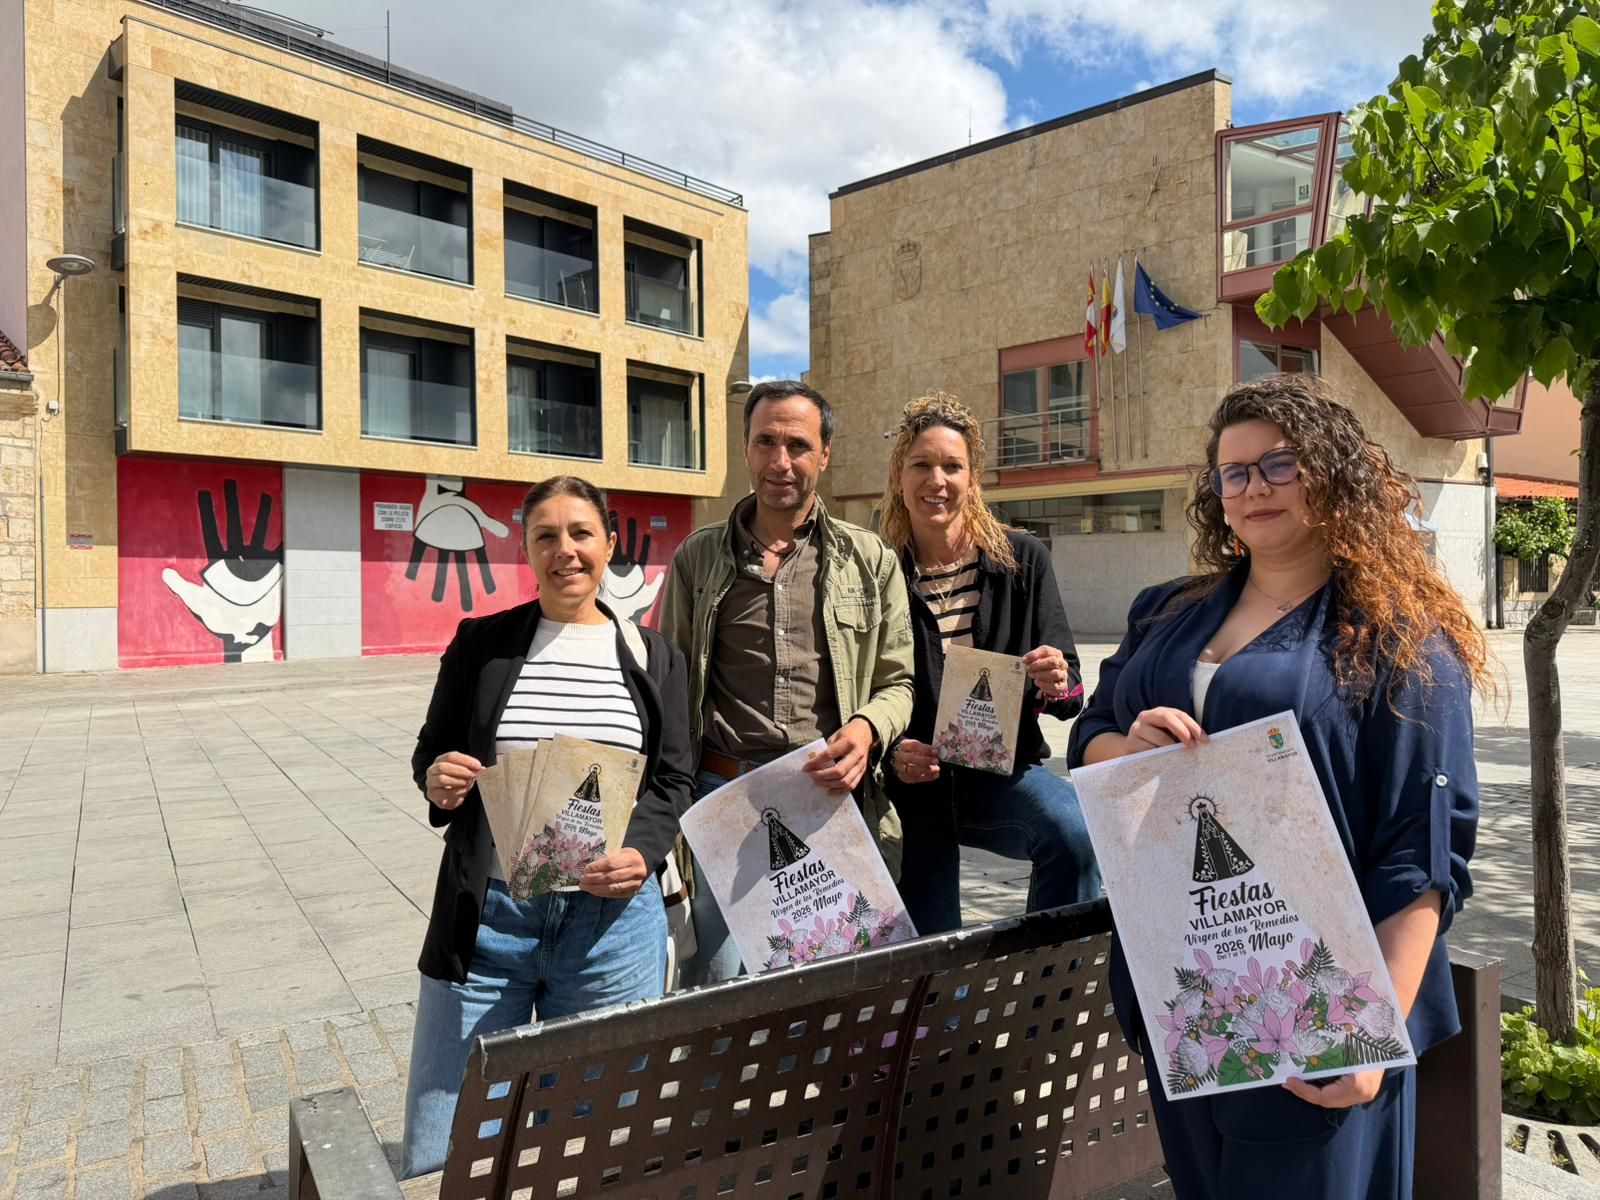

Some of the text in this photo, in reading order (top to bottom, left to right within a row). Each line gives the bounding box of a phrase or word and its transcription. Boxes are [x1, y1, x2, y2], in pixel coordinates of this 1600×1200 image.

[965, 699, 994, 714] Fiestas
[561, 809, 603, 824] VILLAMAYOR
[567, 798, 602, 817] Fiestas
[578, 825, 598, 838] Mayo
[769, 859, 826, 894] Fiestas
[772, 869, 836, 907] VILLAMAYOR
[770, 903, 794, 919] Virgen
[794, 898, 802, 907] de
[802, 894, 812, 902] los
[812, 878, 844, 896] Remedios
[791, 904, 812, 920] 2026
[812, 891, 843, 912] Mayo
[1188, 881, 1275, 916] Fiestas
[1184, 913, 1299, 946] Virgen de los Remedios
[1189, 899, 1287, 931] VILLAMAYOR
[1214, 931, 1295, 955] 2026 Mayo
[1216, 953, 1227, 961] Del
